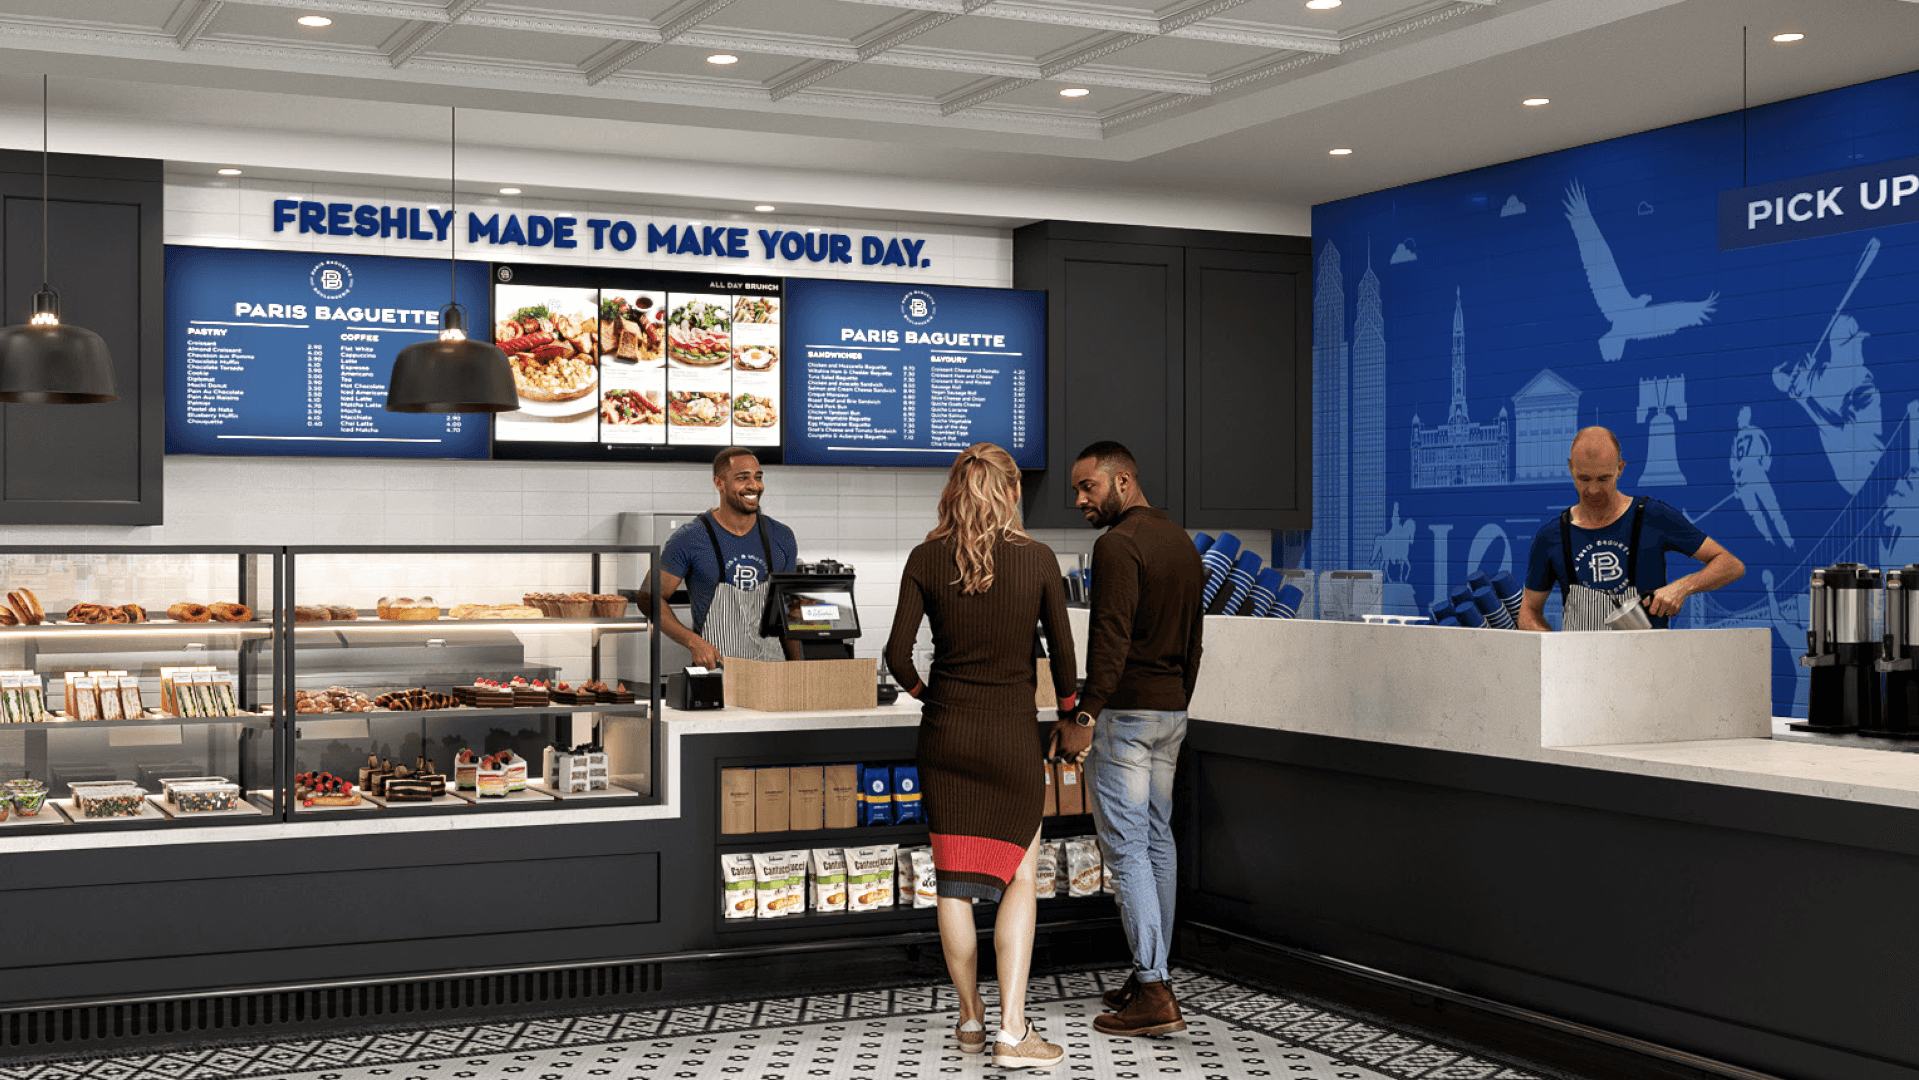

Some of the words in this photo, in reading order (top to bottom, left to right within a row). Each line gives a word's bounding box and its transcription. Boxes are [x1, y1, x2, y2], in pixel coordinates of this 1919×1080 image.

[1748, 186, 1844, 230] PICK
[1860, 174, 1919, 210] UP
[273, 199, 457, 242] FRESHLY
[467, 211, 578, 249] MADE
[587, 218, 637, 252] TO
[647, 223, 750, 259] MAKE
[758, 229, 852, 264] YOUR
[861, 235, 931, 269] DAY.
[709, 281, 726, 289] ALL
[744, 283, 779, 291] BRUNCH
[235, 302, 308, 320] PARIS
[314, 305, 440, 325] BAGUETTE
[187, 327, 228, 336] PASTRY
[340, 333, 379, 342] COFFEE
[841, 328, 899, 343] PARIS
[905, 331, 1006, 348] BAGUETTE
[340, 352, 376, 360] Cappuccino
[807, 351, 863, 360] SANDWICHES
[930, 356, 968, 364] SAVOURY
[187, 376, 215, 384] Diplomat
[1736, 434, 1753, 462] 67
